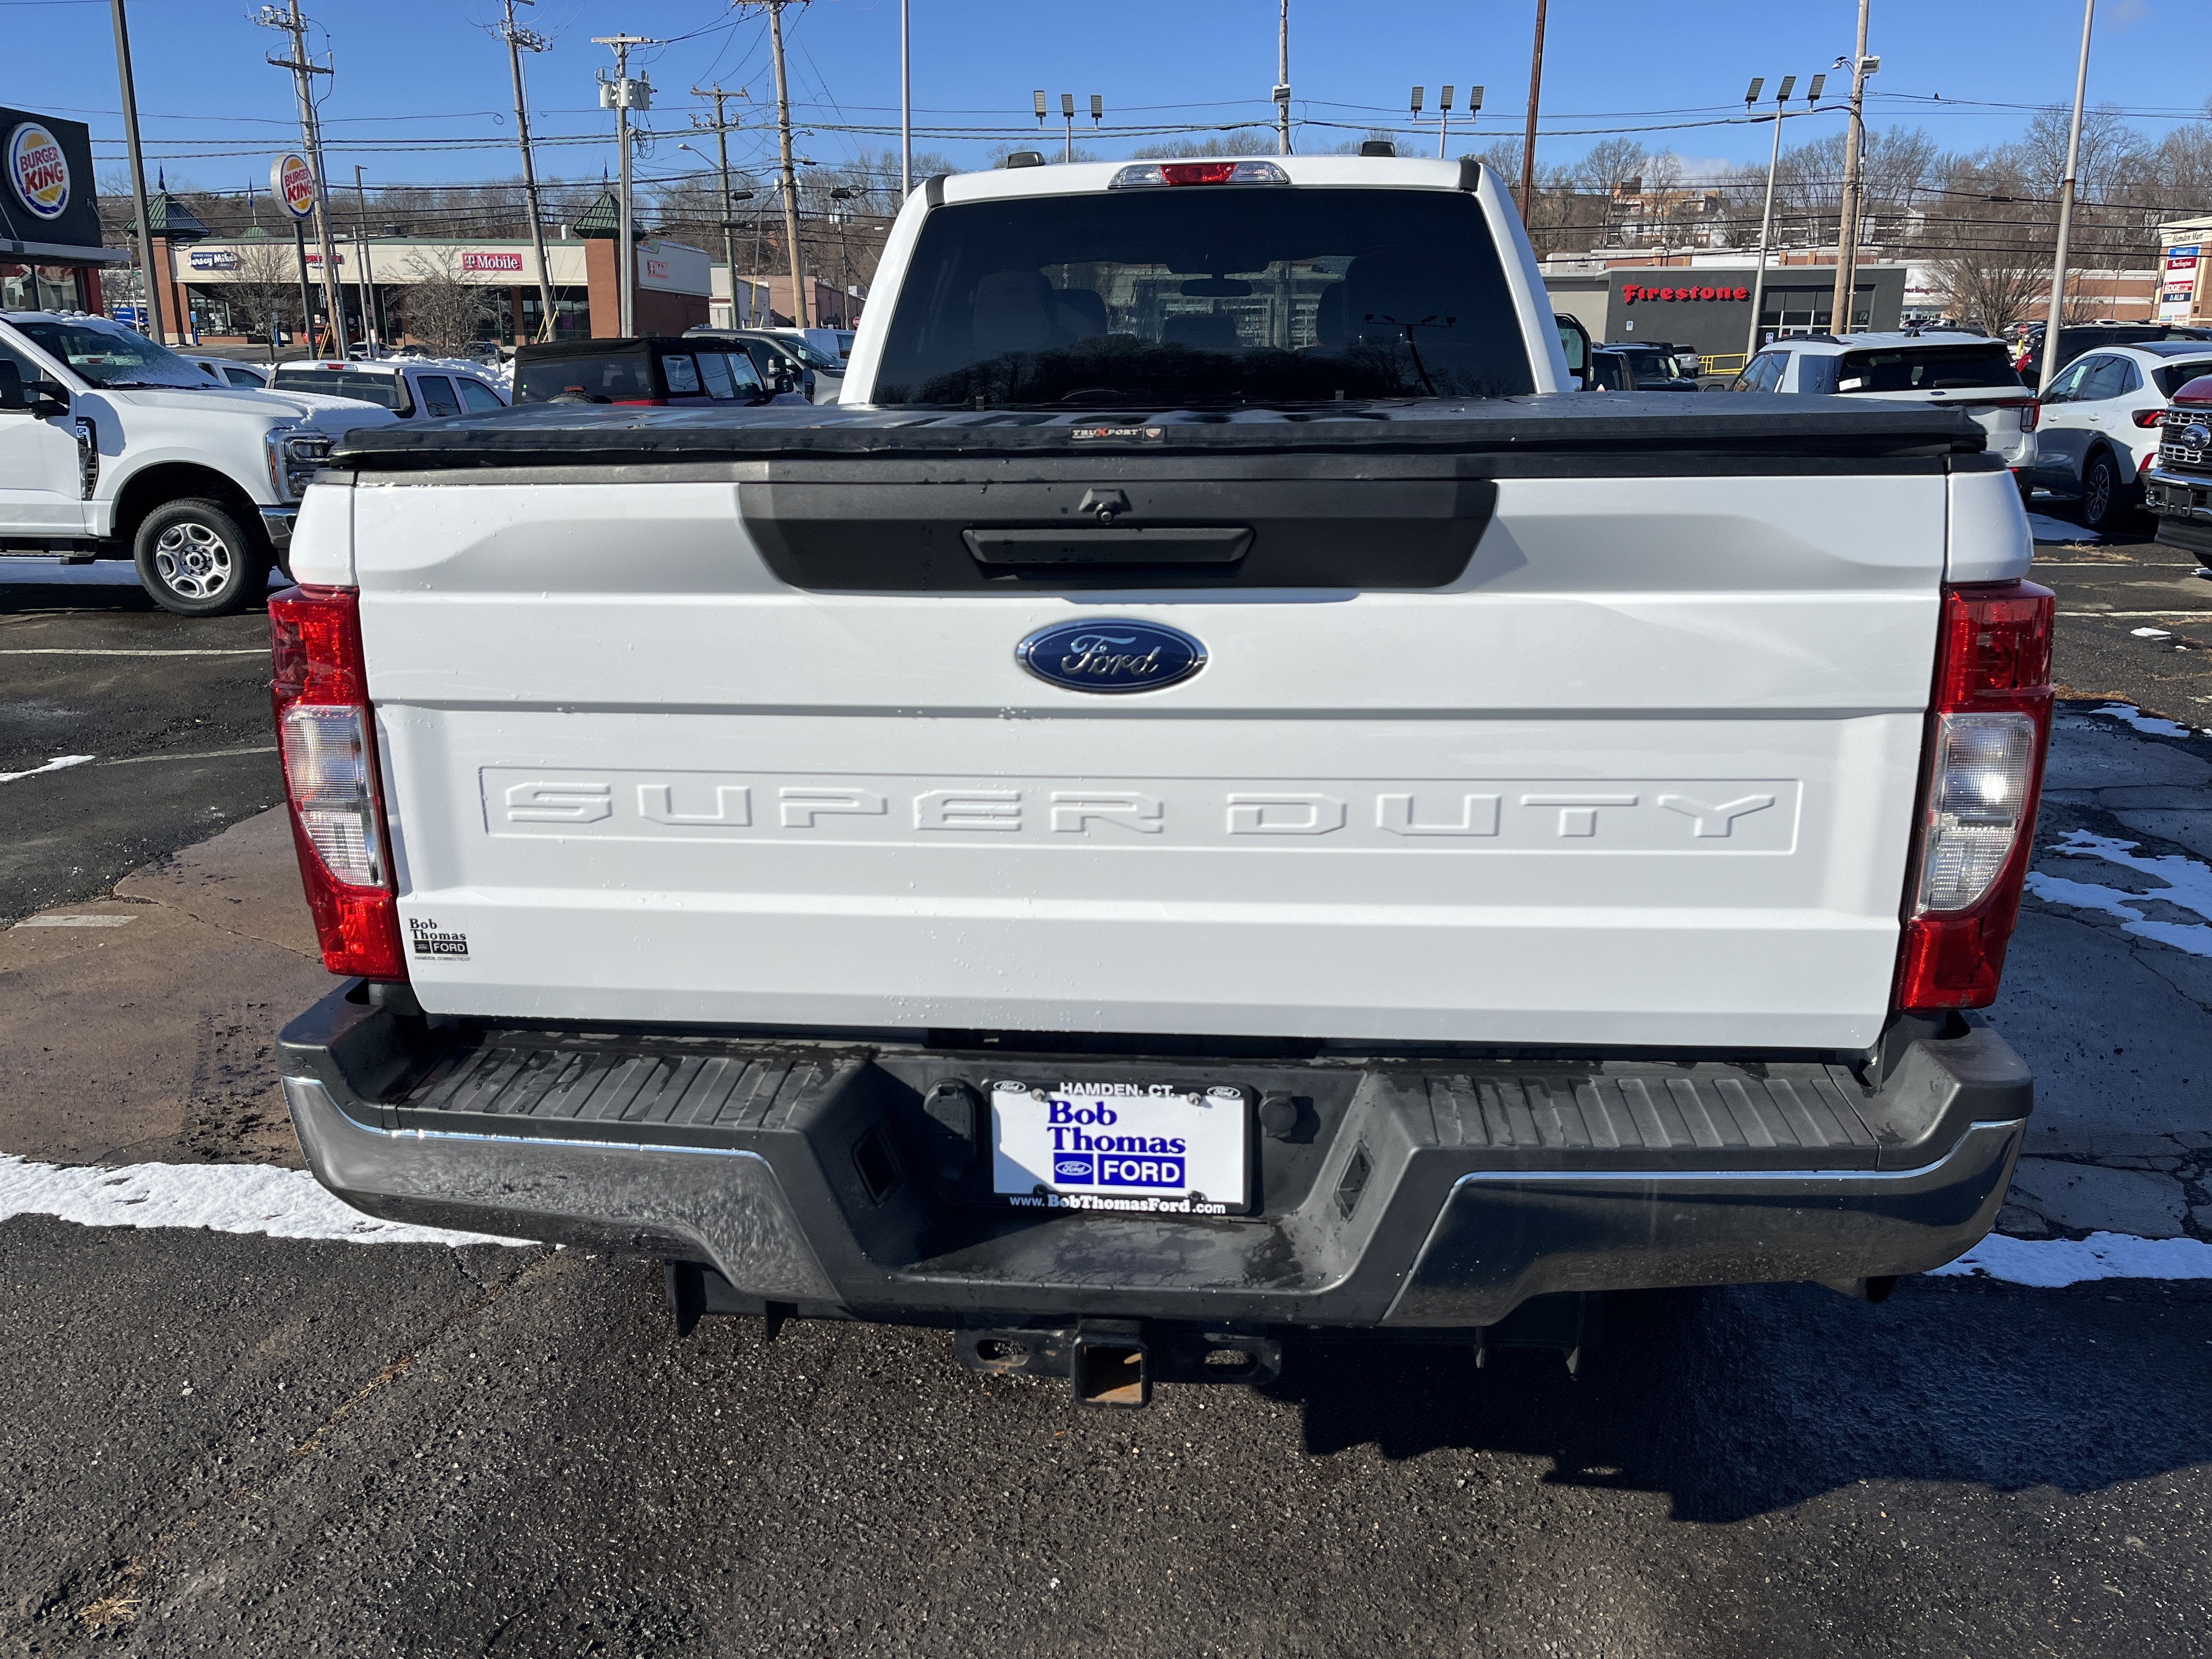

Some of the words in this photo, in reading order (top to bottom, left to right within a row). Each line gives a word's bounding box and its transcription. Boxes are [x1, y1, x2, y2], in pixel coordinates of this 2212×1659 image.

[20, 146, 59, 172] BURGER
[25, 161, 64, 195] KING
[285, 168, 309, 187] BURGER
[287, 180, 312, 204] KING
[187, 257, 213, 267] Jersey
[1622, 284, 1747, 303] Firestone
[2164, 284, 2181, 292] EDGE
[1060, 634, 1162, 676] Ford
[506, 782, 1163, 833] SUPER
[1227, 793, 1775, 837] DUTY
[409, 918, 437, 929] Bob
[410, 929, 467, 940] Thomas
[433, 943, 465, 952] FORD
[1060, 1082, 1144, 1097] HAMDEN,
[1148, 1084, 1176, 1097] CT.
[1048, 1100, 1118, 1125] Bob
[1047, 1126, 1186, 1154] Thomas
[1103, 1160, 1180, 1183] FORD
